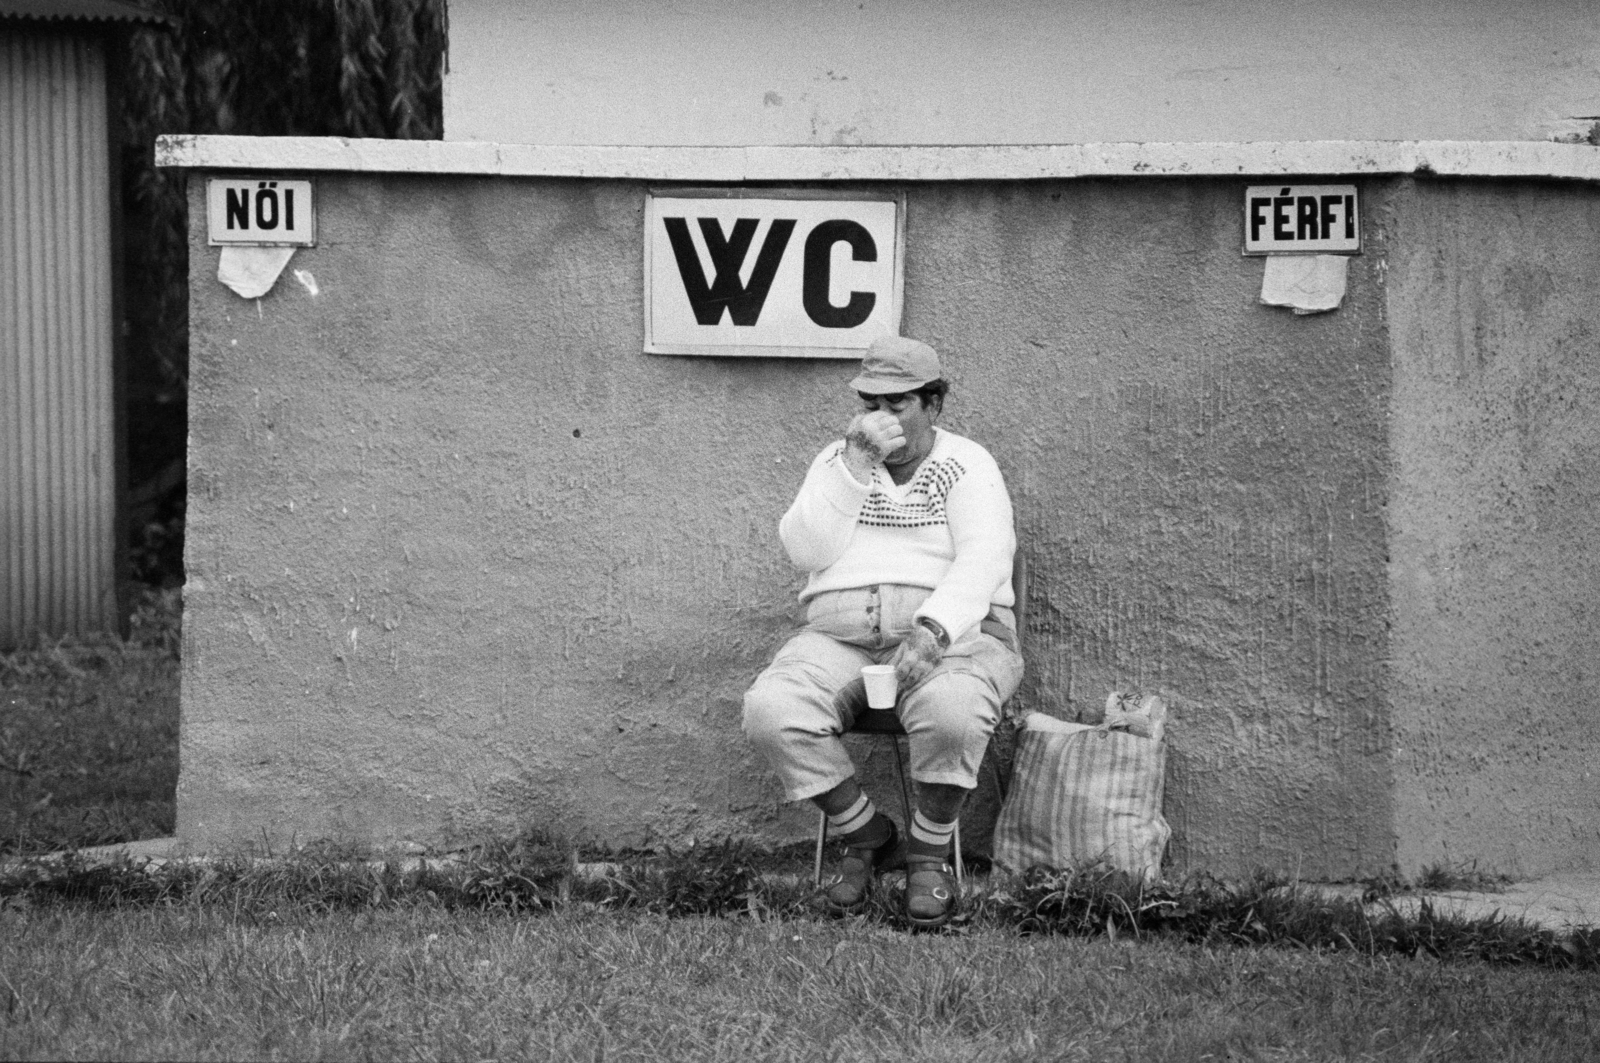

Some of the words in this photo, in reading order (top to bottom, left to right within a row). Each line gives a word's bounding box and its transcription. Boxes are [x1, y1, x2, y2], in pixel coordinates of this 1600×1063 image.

[226, 182, 294, 231] NŐI
[1251, 187, 1355, 241] FÉRFI
[663, 217, 878, 329] WC
